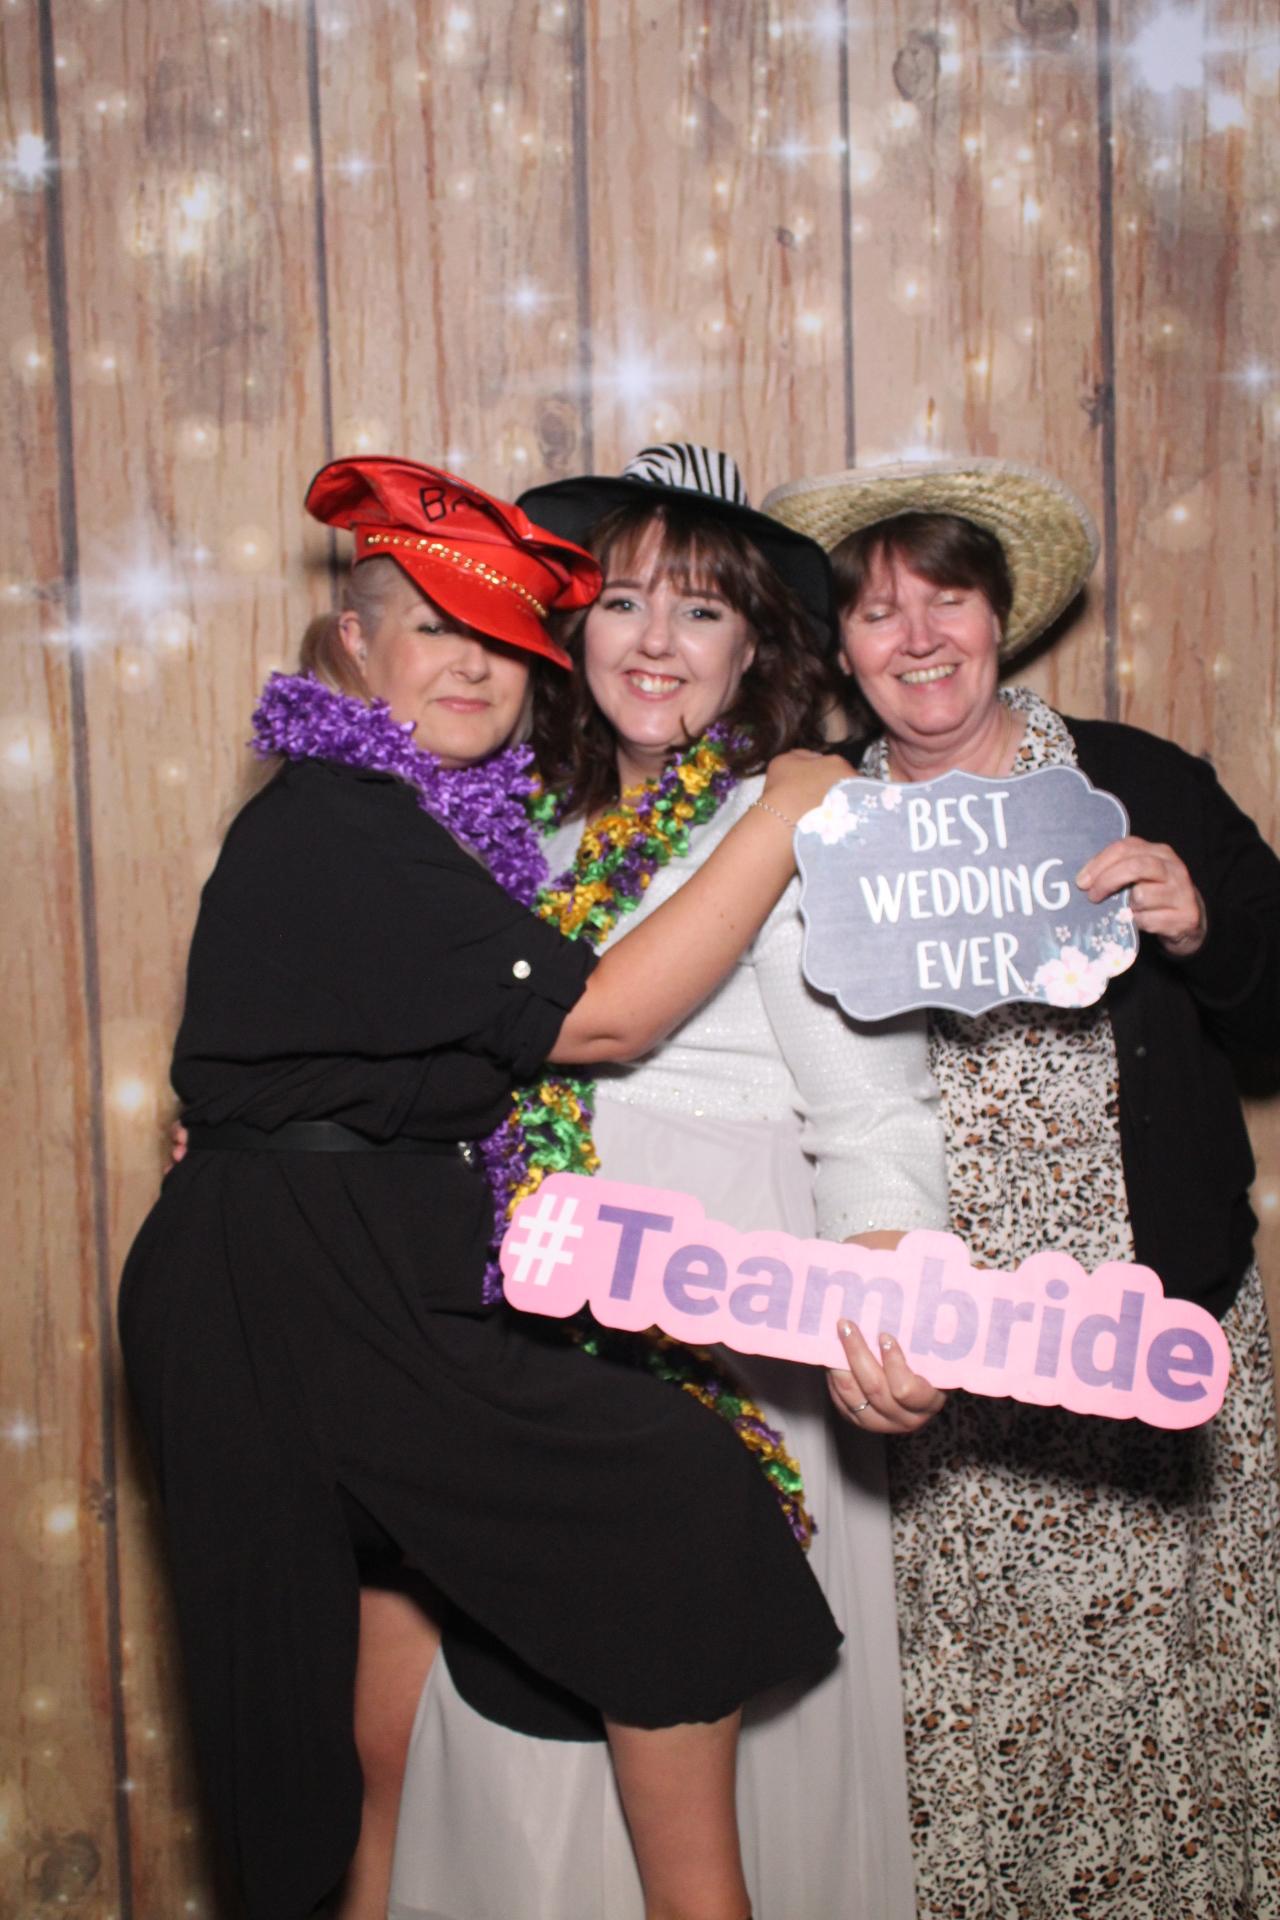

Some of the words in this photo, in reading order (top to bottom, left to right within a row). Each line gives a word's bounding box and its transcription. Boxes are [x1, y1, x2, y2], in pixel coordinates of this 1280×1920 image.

[908, 791, 1009, 855] BEST
[860, 859, 1071, 924] WEDDING
[916, 932, 1031, 997] EVER
[508, 1193, 1215, 1403] #Teambride
